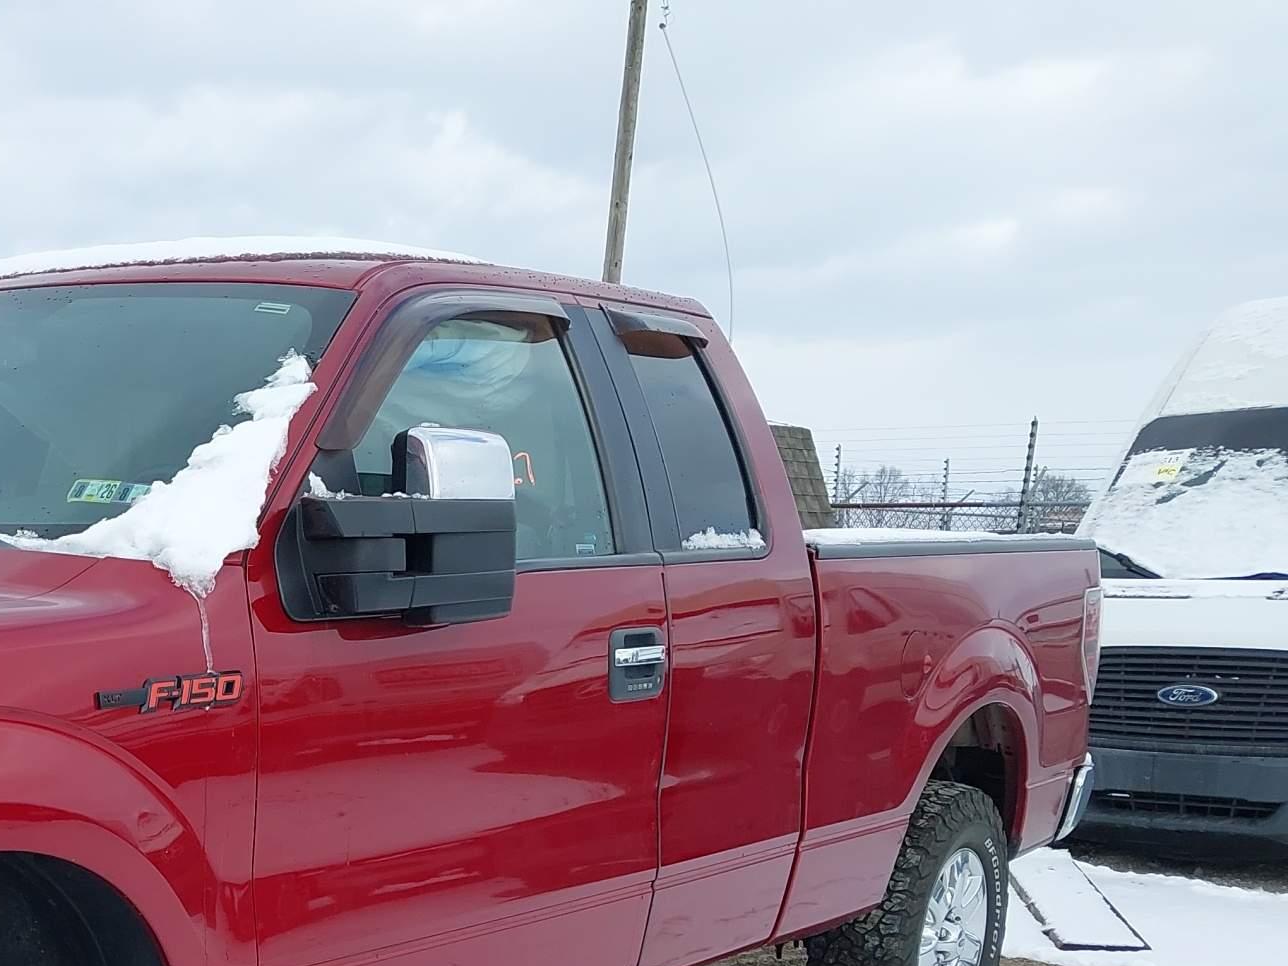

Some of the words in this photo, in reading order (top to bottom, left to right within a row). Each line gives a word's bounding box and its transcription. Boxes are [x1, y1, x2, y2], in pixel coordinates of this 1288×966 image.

[148, 674, 243, 709] F-150
[1168, 688, 1204, 703] Ford
[984, 838, 1002, 960] BFGoodrich
